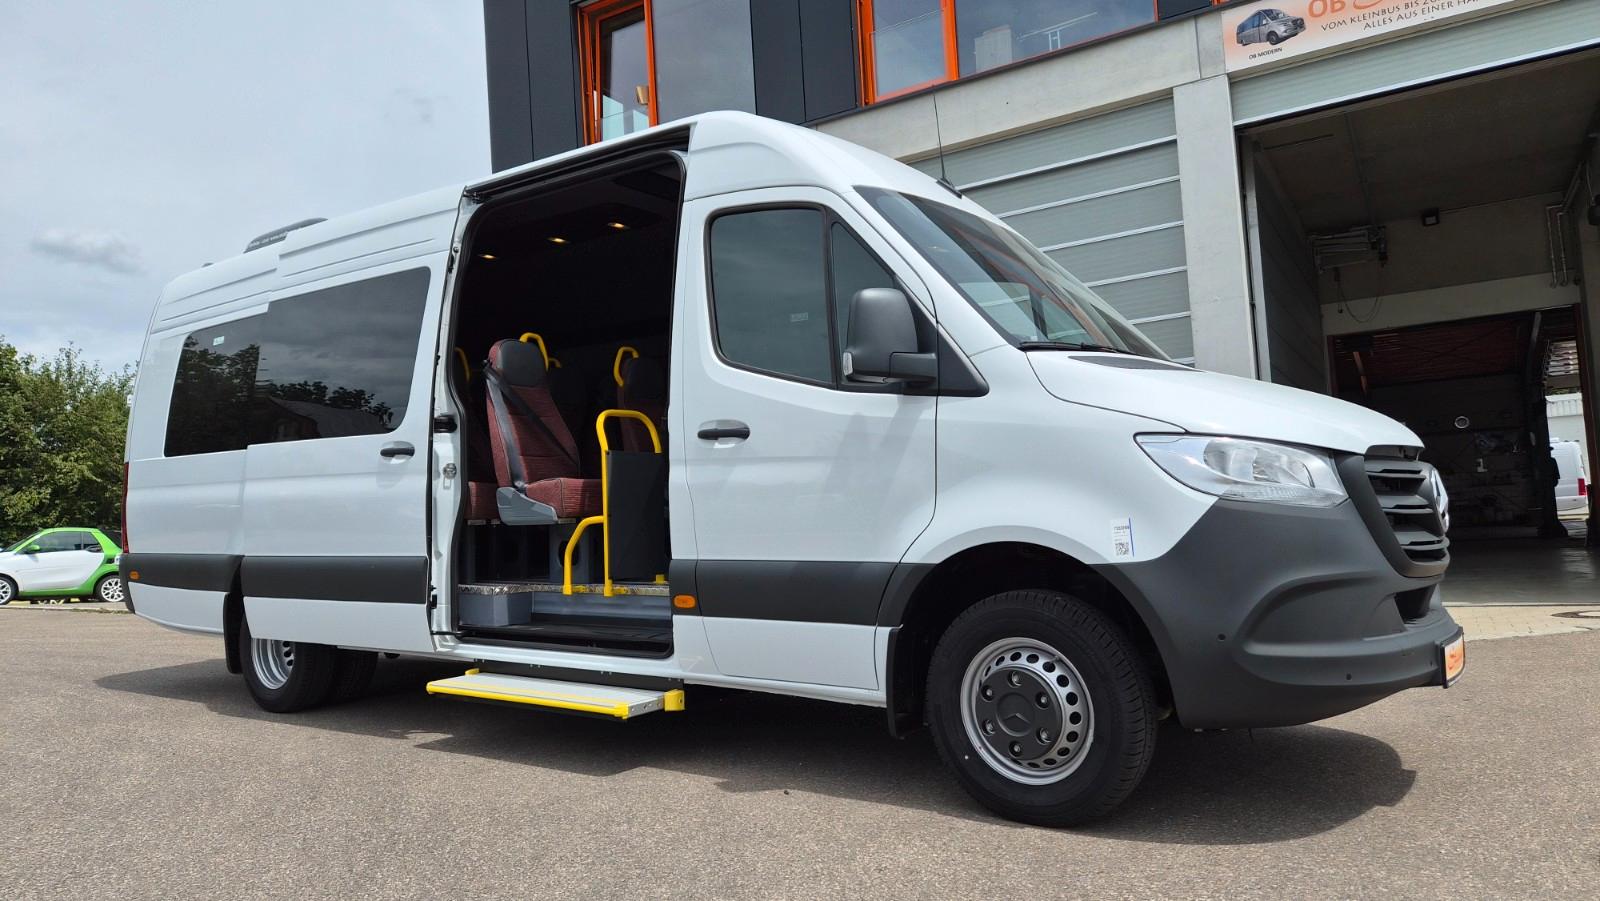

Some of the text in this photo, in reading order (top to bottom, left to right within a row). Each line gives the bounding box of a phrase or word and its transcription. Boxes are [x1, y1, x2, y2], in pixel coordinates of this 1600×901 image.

[1308, 0, 1346, 17] OB
[1321, 19, 1348, 31] VOM
[1350, 6, 1401, 24] KLEINBUS
[1404, 0, 1419, 10] BIS
[1363, 16, 1393, 31] ALLES
[1396, 10, 1418, 21] AUS
[1421, 0, 1454, 16] EINER
